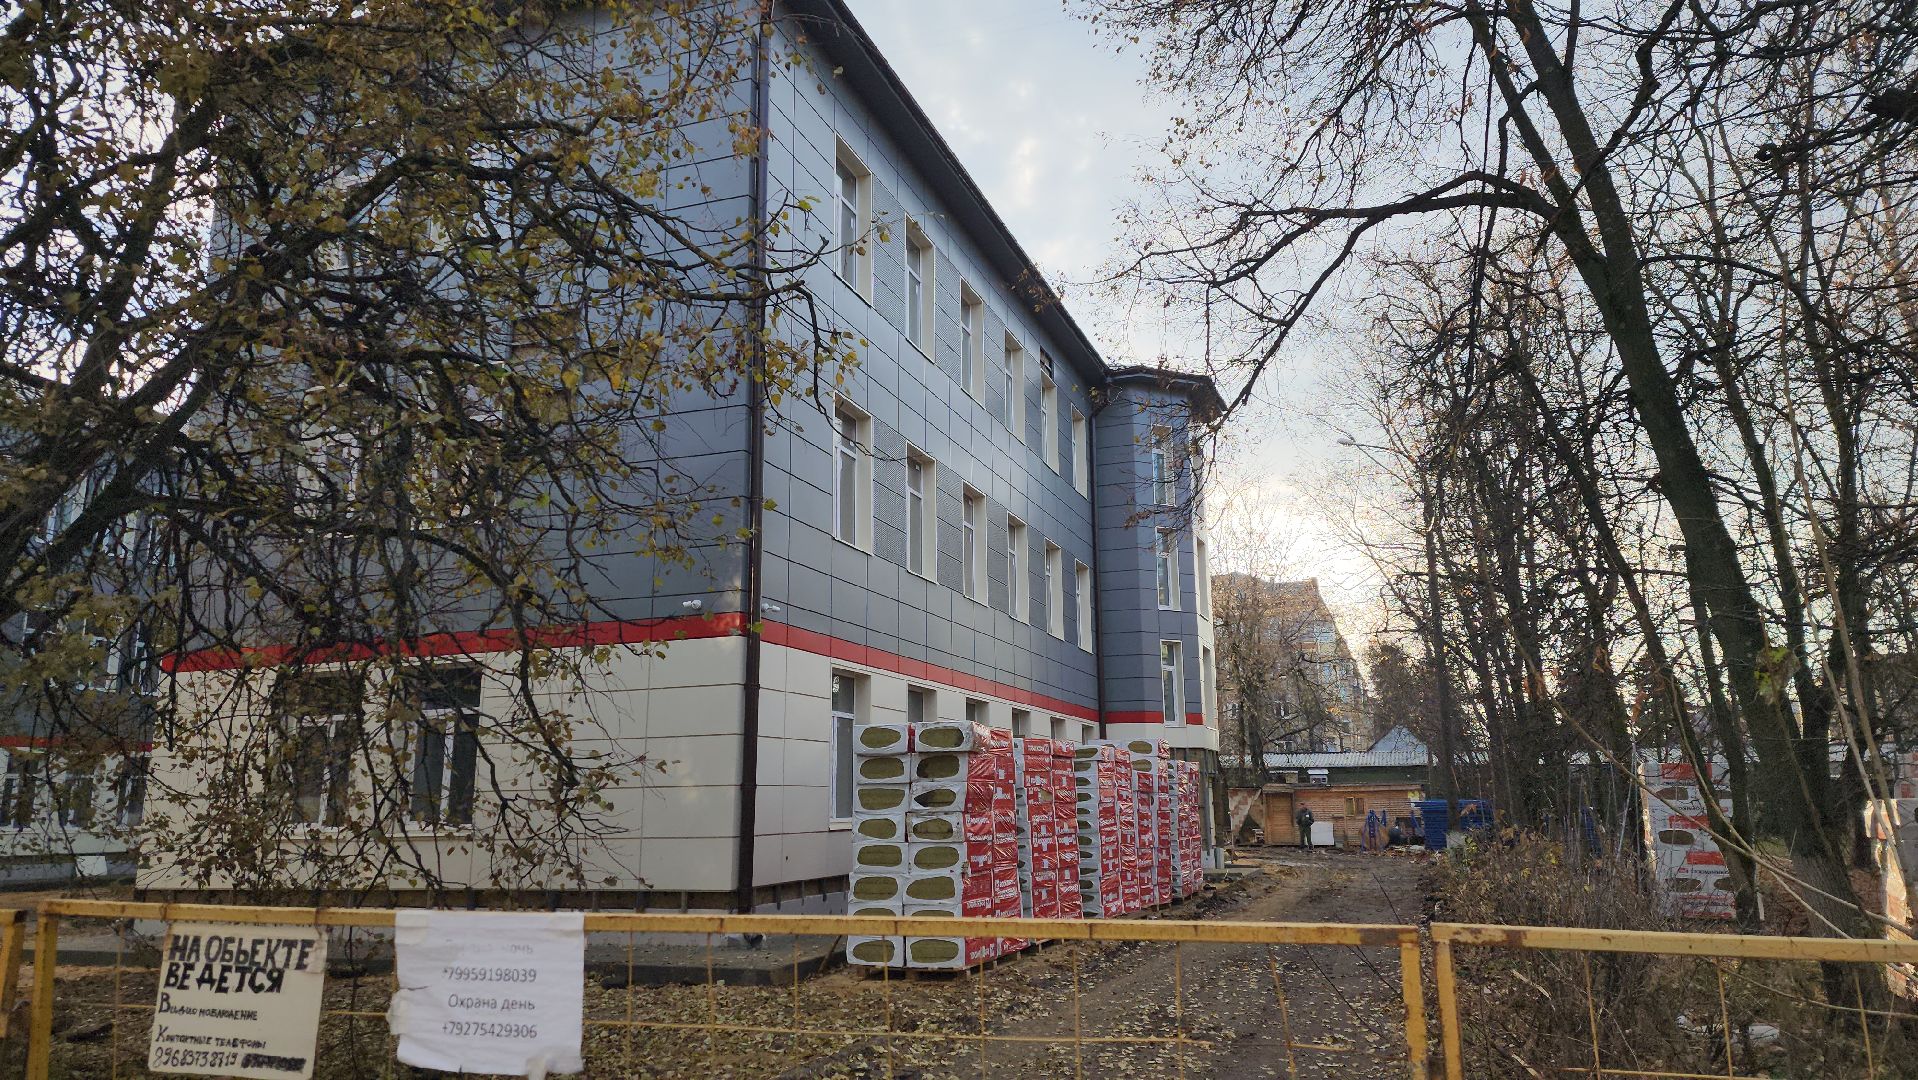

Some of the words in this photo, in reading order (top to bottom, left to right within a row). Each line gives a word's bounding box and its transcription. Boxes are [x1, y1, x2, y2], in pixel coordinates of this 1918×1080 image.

[169, 934, 201, 962] НА
[447, 993, 498, 1010] Охрана
[501, 998, 536, 1011] день
[442, 1021, 538, 1038] +79275429306
